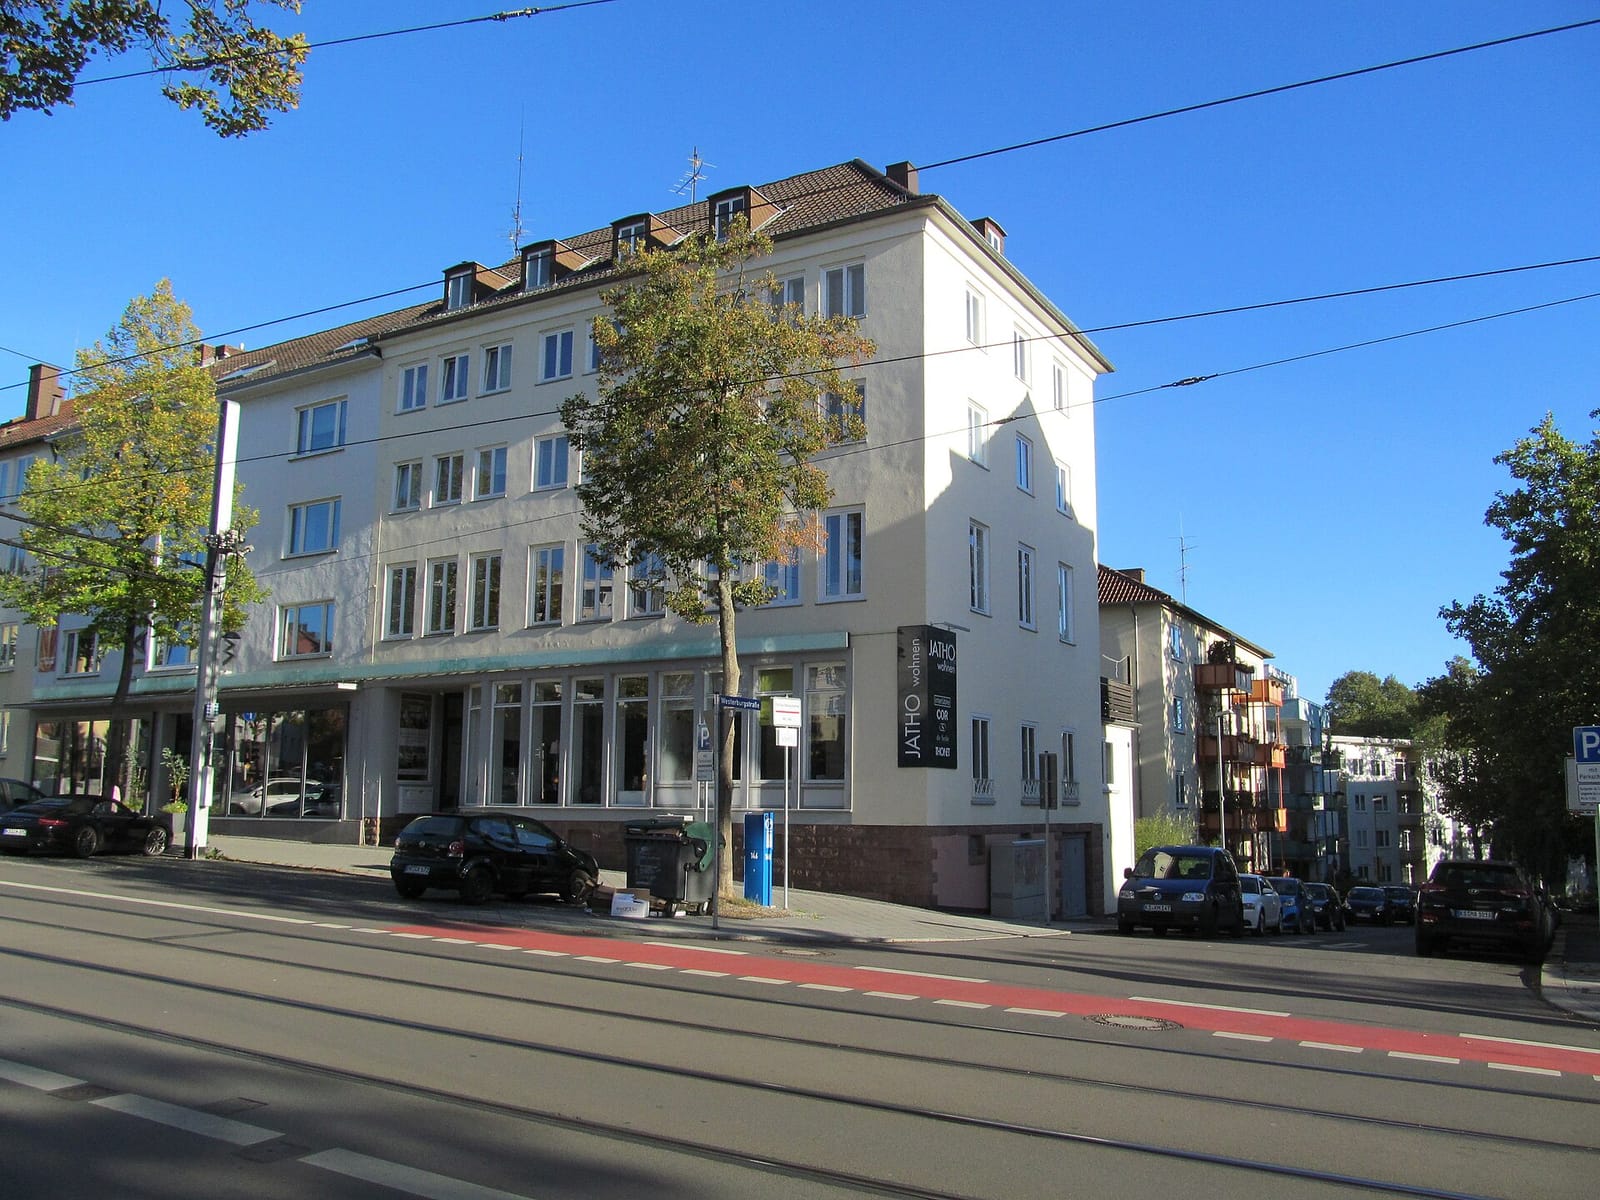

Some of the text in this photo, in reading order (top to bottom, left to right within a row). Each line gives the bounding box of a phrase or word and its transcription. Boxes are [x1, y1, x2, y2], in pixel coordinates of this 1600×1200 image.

[929, 639, 956, 661] JATHO
[937, 661, 956, 674] wohnen
[904, 638, 921, 758] JATHO wohnen
[936, 709, 949, 721] COR
